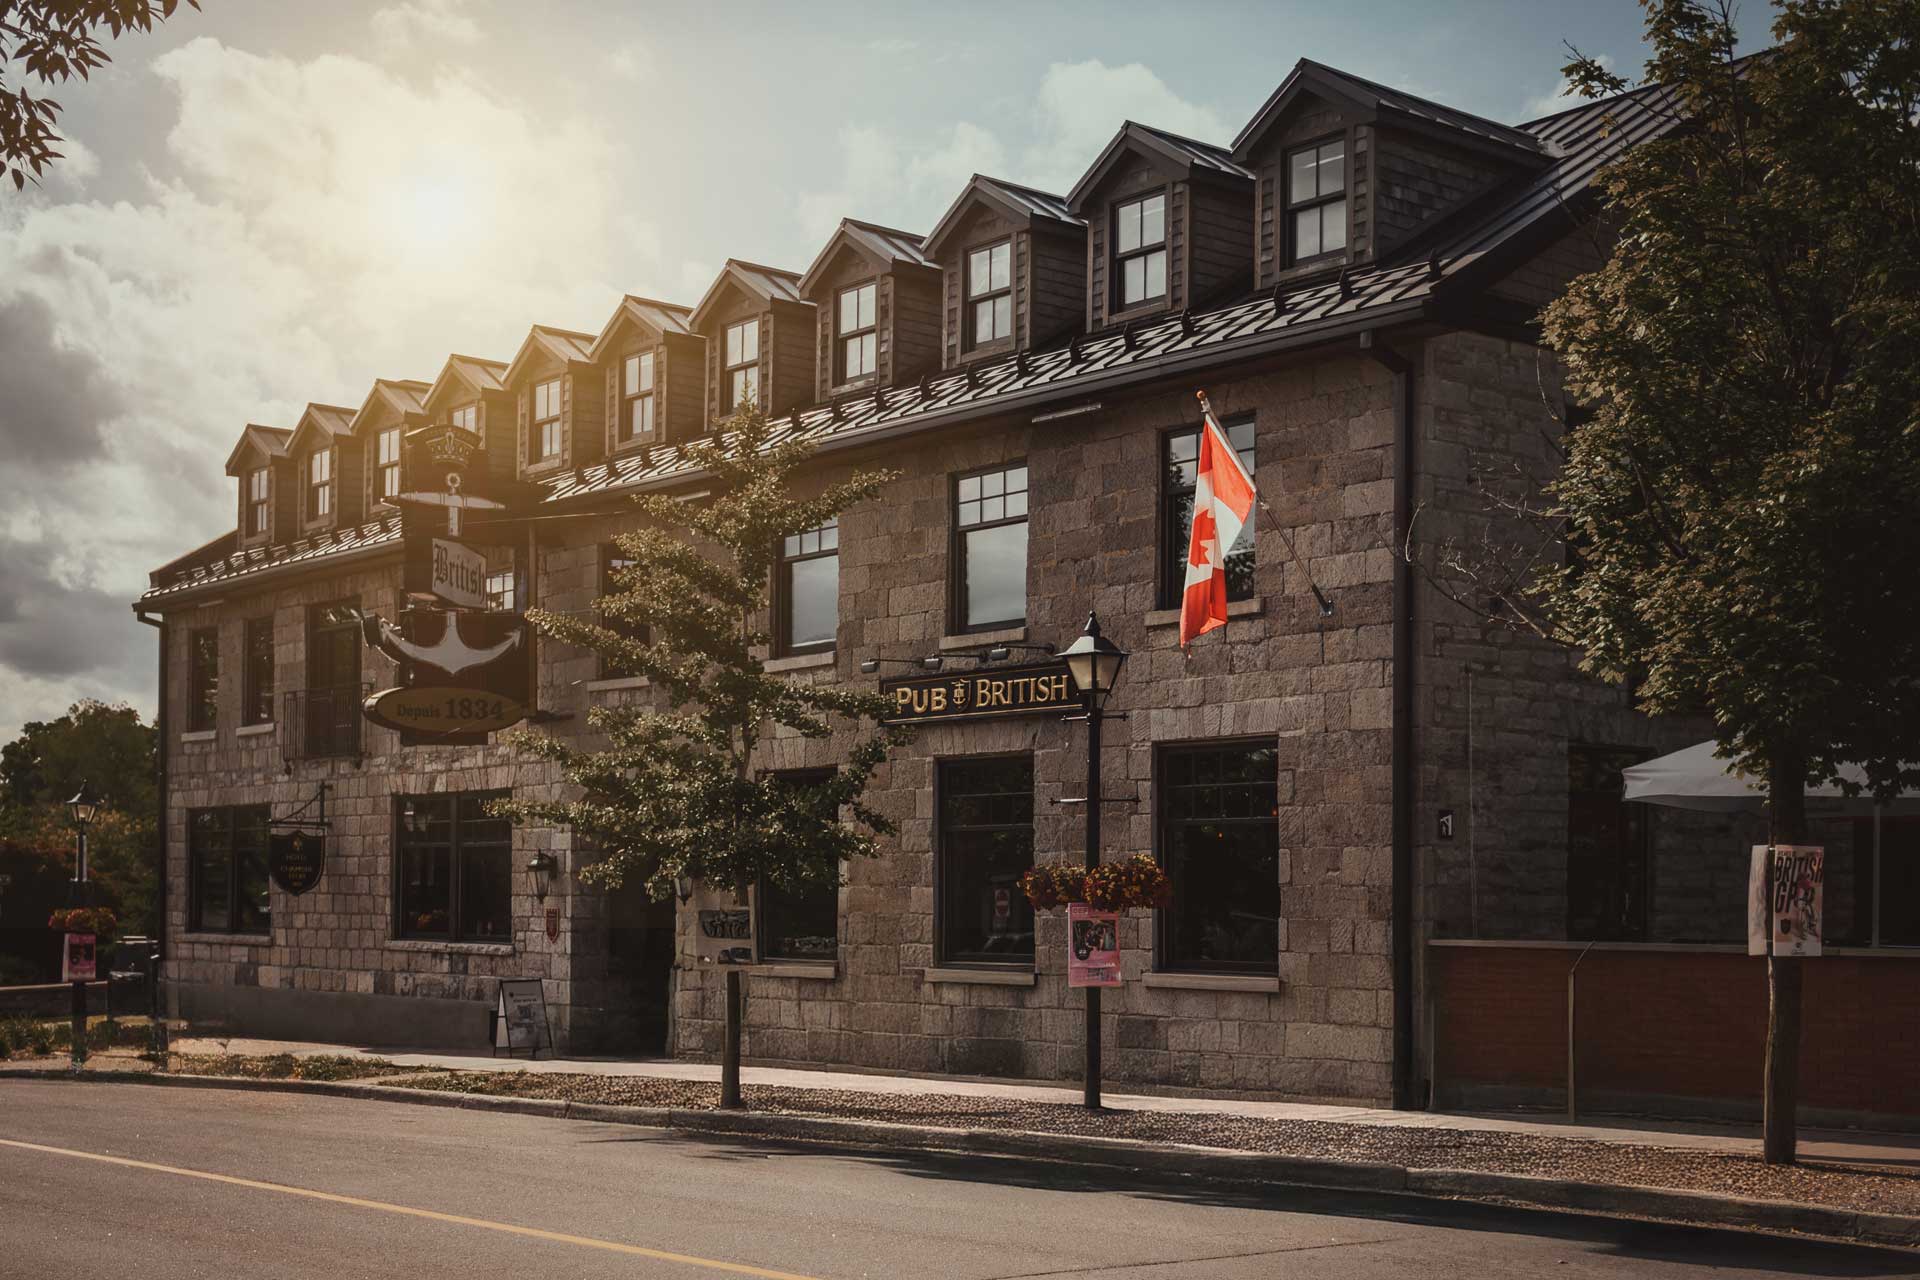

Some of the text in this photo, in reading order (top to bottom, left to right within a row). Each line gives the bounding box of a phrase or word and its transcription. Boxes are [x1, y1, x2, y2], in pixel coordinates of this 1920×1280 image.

[434, 544, 485, 604] British
[398, 698, 504, 721] Depuis 1834
[895, 675, 1069, 714] PUB BRITISH
[1776, 857, 1824, 882] BRITISH
